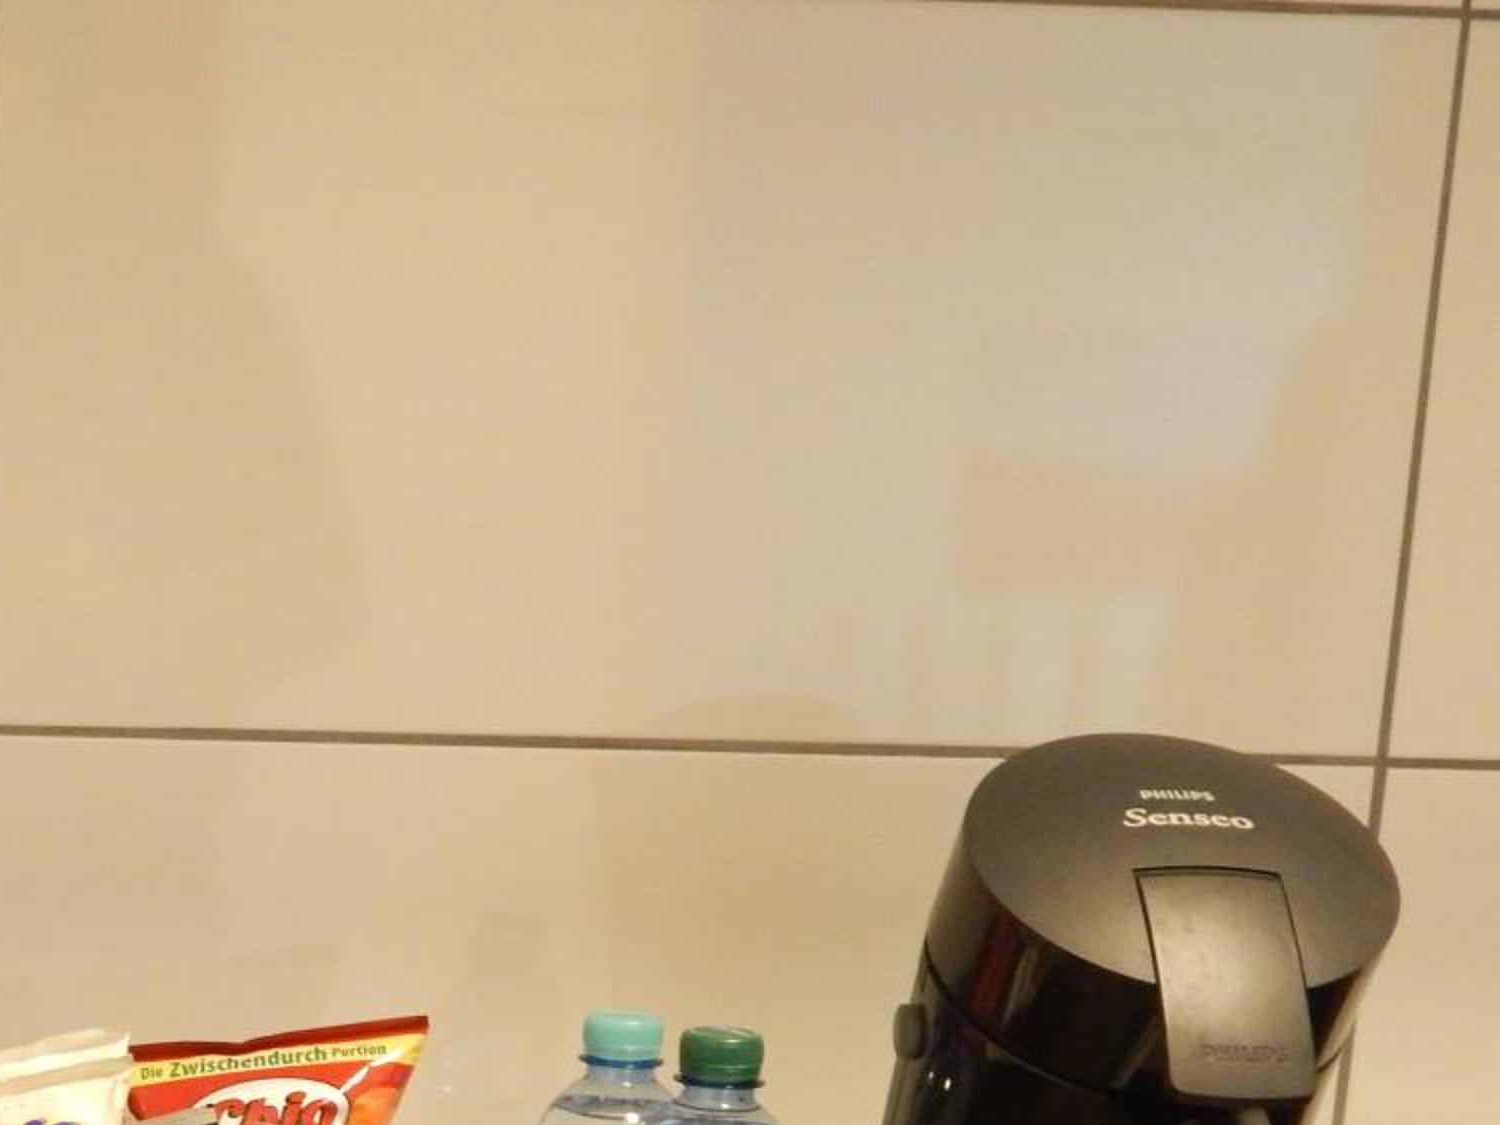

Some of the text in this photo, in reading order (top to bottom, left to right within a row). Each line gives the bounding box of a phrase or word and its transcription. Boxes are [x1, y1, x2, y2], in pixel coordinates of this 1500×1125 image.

[1140, 789, 1215, 802] PHILIPS
[1123, 807, 1254, 830] Senseo
[140, 1043, 387, 1081] Die Zwischendurch Portion
